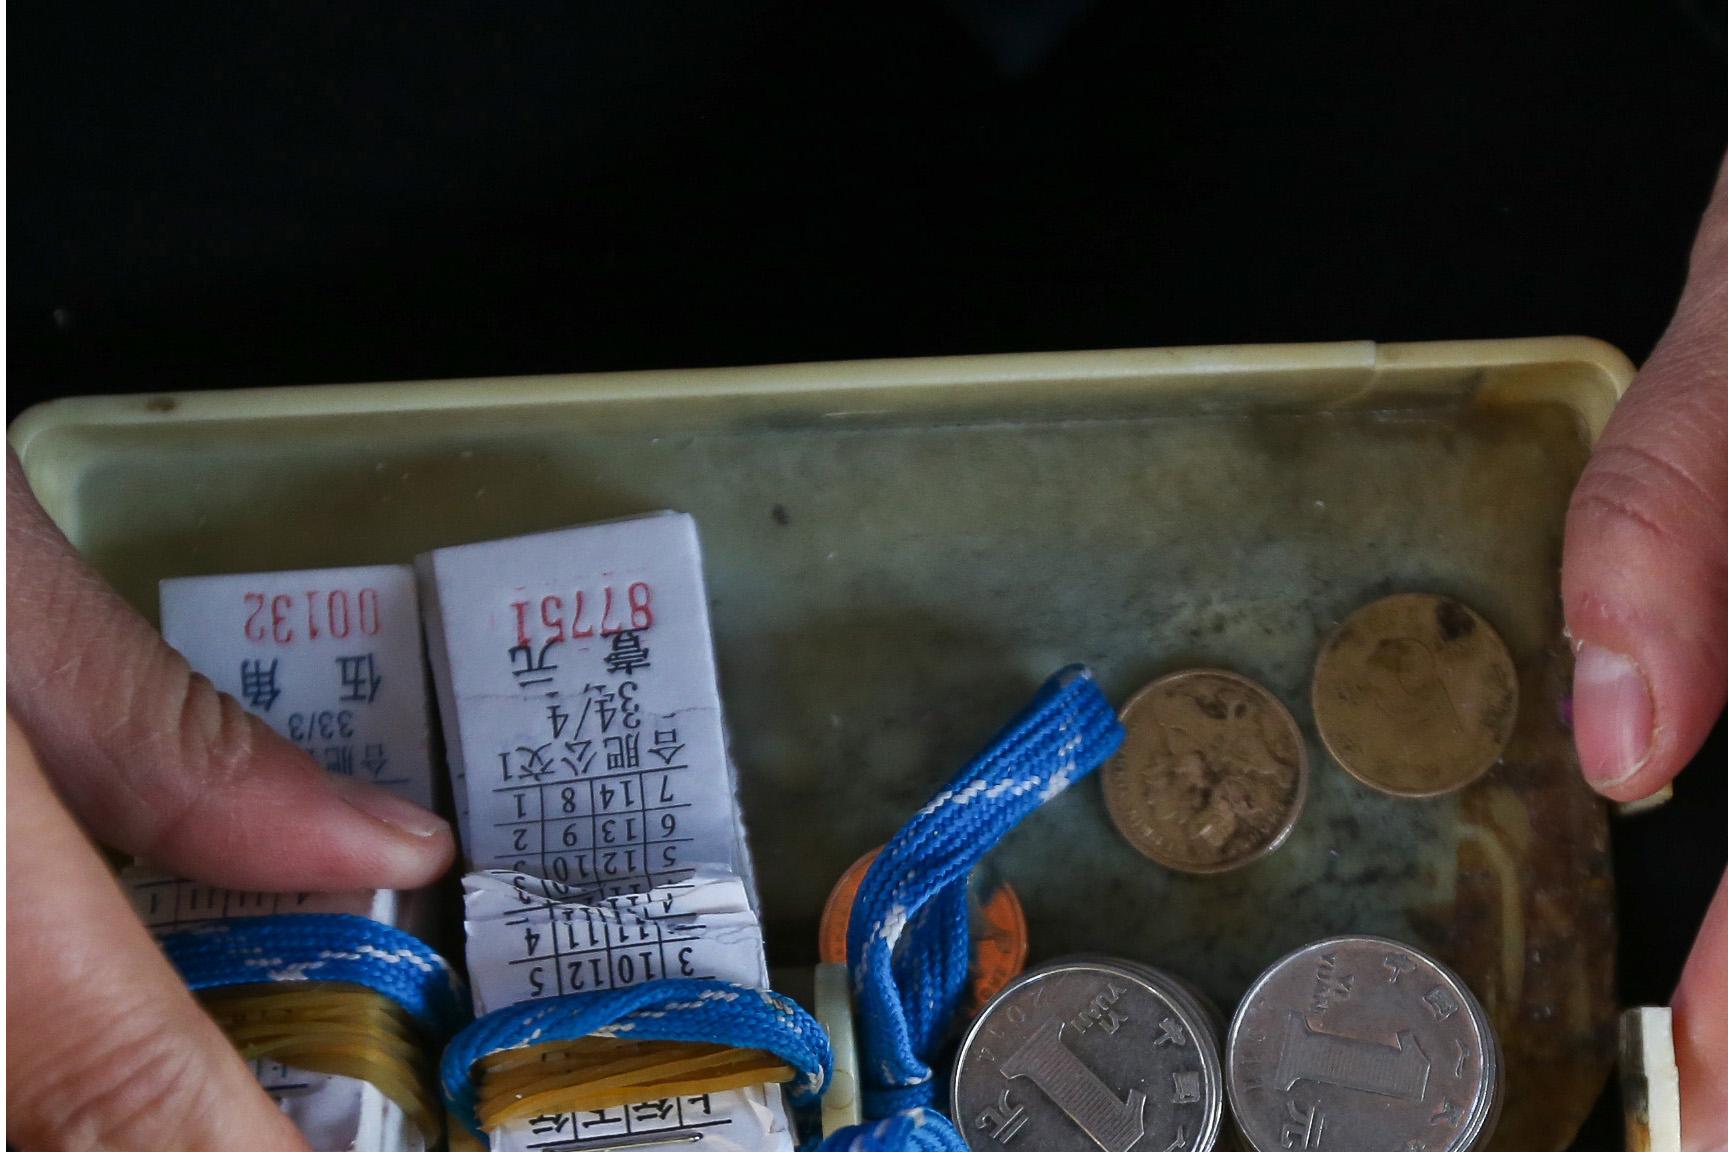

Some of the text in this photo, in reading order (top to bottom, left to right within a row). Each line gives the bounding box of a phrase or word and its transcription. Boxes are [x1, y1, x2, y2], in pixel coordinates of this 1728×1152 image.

[242, 587, 382, 648] 00132
[510, 580, 656, 648] 87751
[287, 710, 354, 743] 33/3
[306, 743, 389, 777] 合肥
[513, 774, 675, 818] 7 14 8 1
[512, 812, 677, 852] 6 13 9 2
[603, 848, 638, 874] 12
[662, 845, 678, 869] 5
[524, 928, 541, 956] 4
[528, 947, 694, 998] 3 10 12 5
